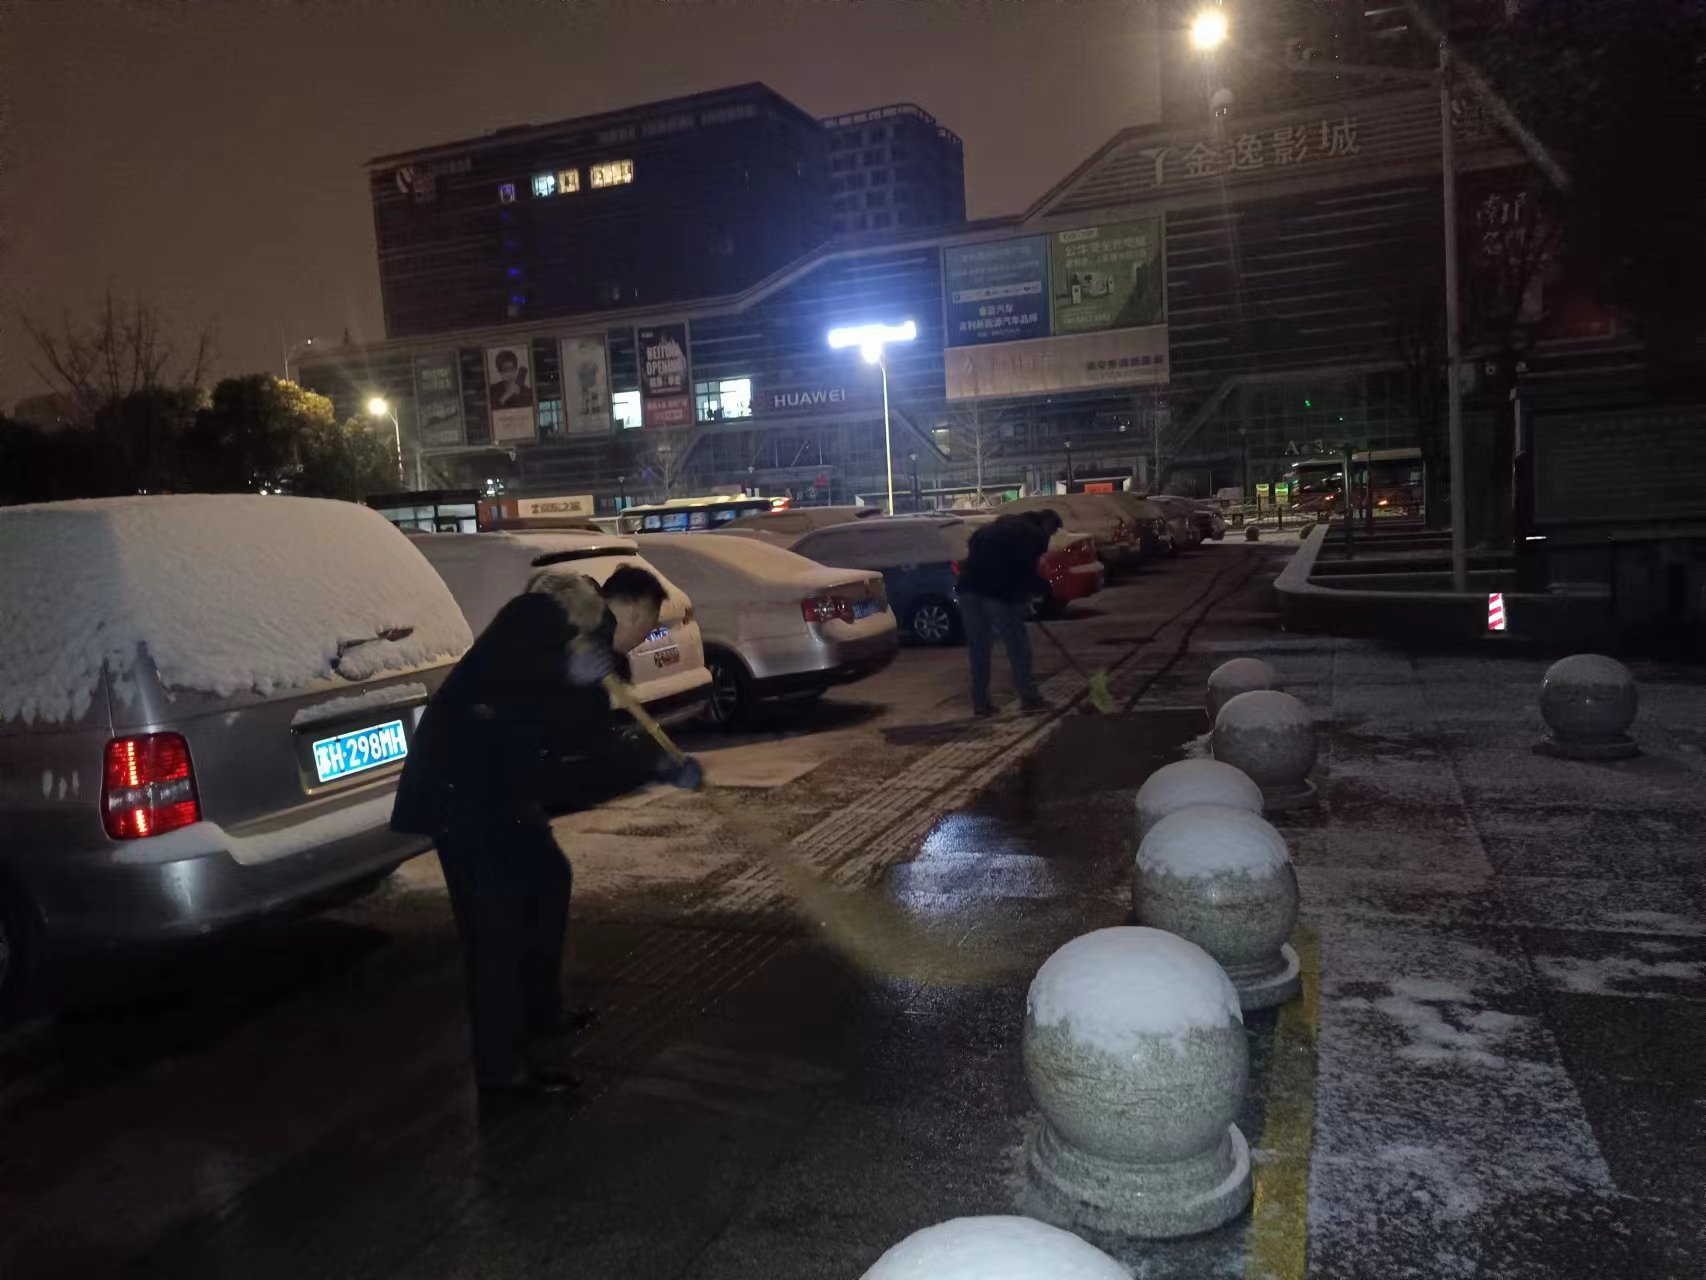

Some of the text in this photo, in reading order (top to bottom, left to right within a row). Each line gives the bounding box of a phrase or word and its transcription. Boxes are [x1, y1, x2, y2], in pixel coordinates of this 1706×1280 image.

[1183, 117, 1359, 178] 金逸影城
[773, 388, 847, 408] HUAWEI
